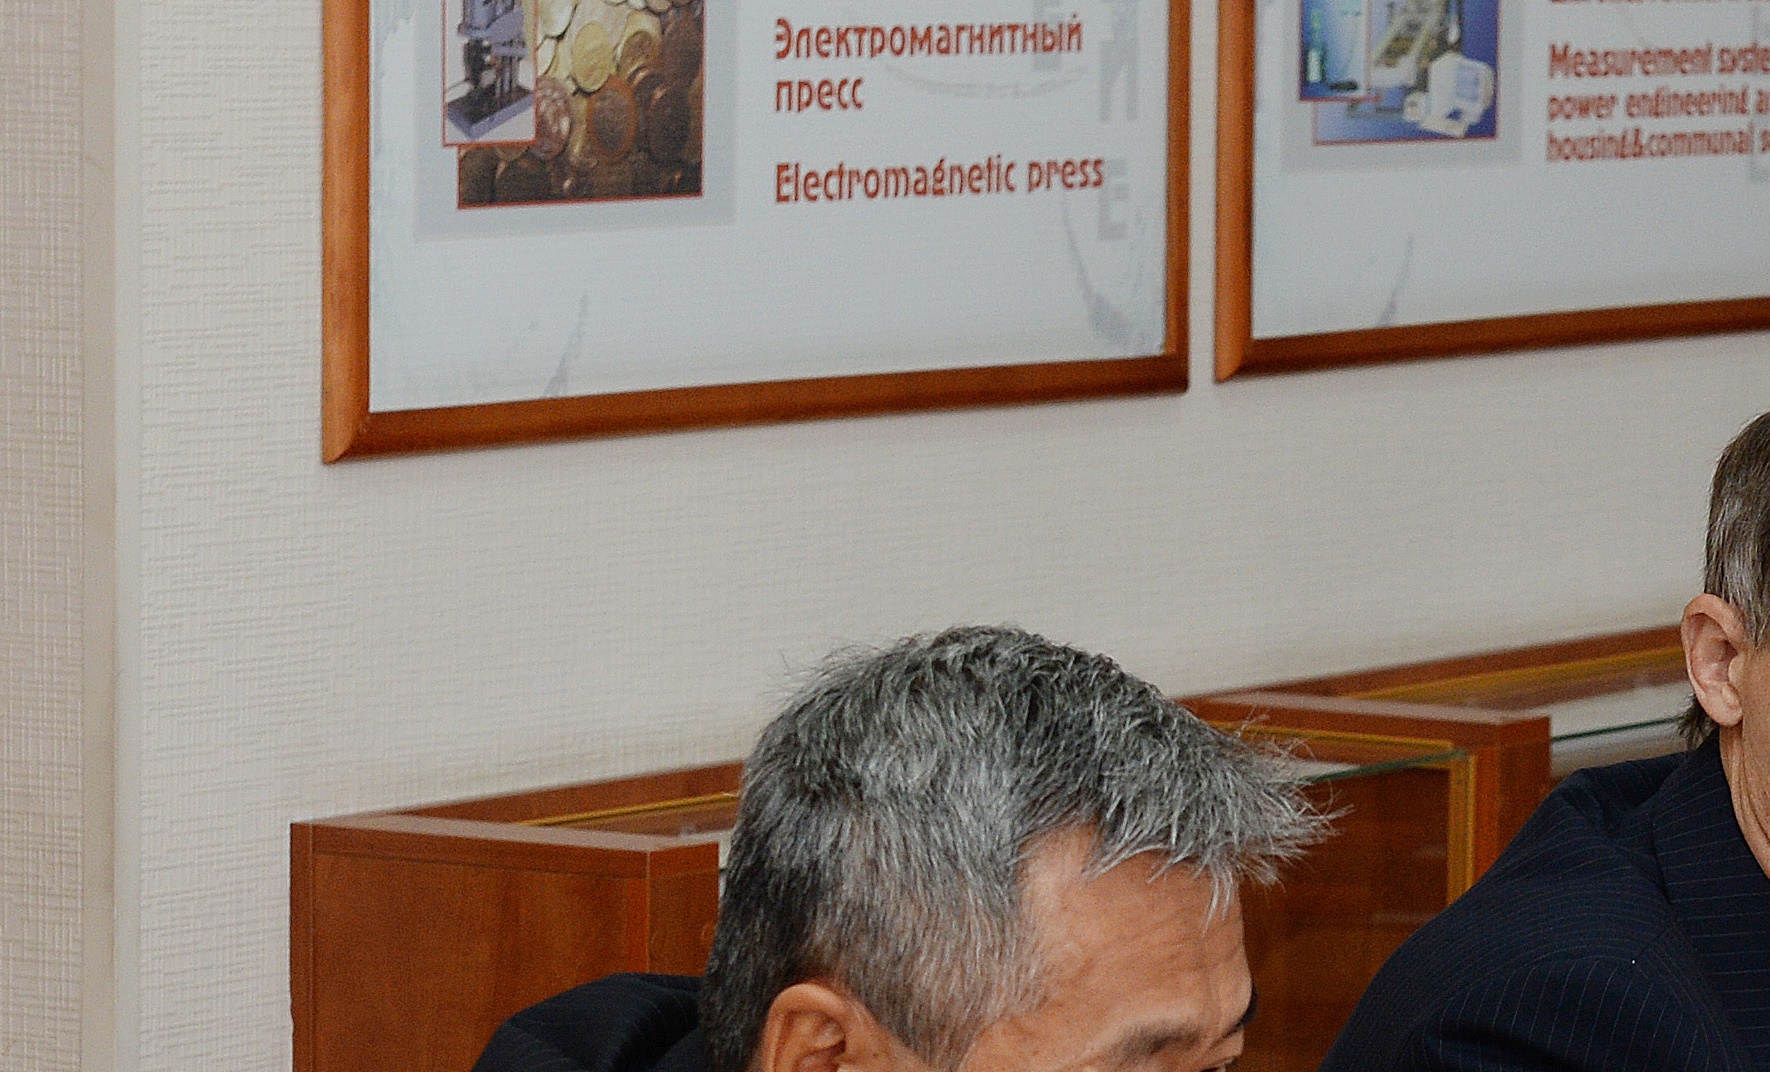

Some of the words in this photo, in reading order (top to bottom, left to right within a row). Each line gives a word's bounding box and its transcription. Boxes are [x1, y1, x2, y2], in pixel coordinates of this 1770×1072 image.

[776, 13, 1083, 59] Электромагнитный
[1548, 42, 1713, 78] Measurement
[776, 78, 863, 113] пресс
[1547, 94, 1618, 120] power
[1625, 85, 1750, 119] engineering
[776, 155, 1016, 202] Electromagnetic
[1028, 157, 1105, 194] press
